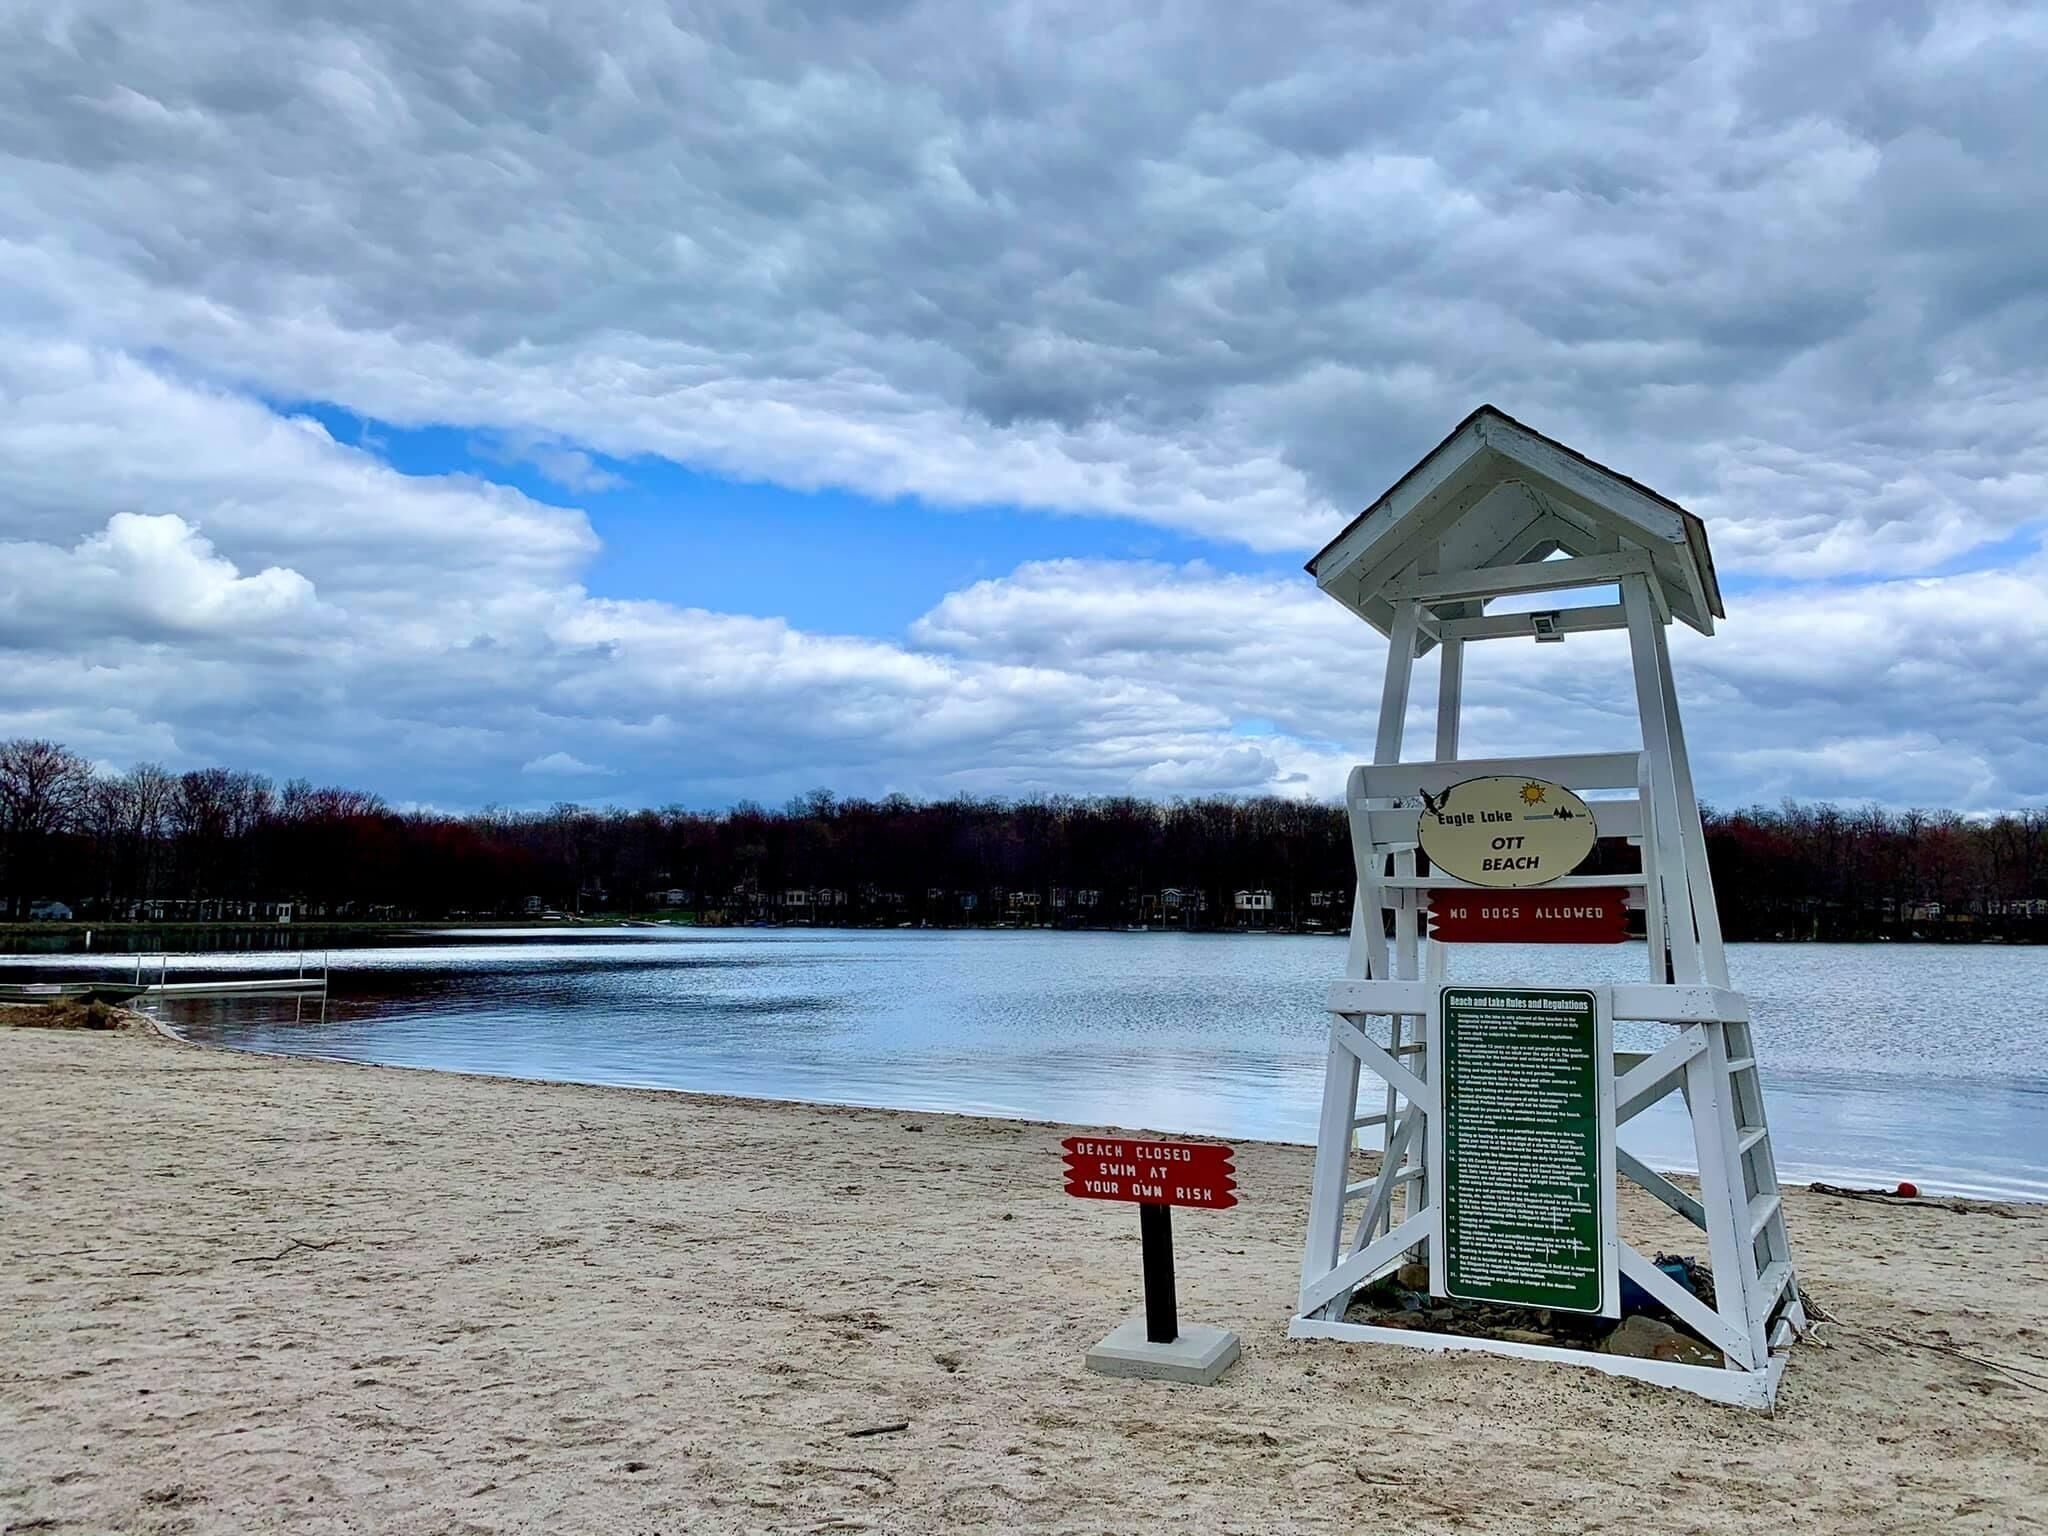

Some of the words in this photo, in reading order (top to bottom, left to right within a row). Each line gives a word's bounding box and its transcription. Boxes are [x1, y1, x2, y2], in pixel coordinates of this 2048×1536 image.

[1438, 812, 1475, 827] Eagle
[1481, 810, 1513, 824] Lake
[1491, 836, 1525, 850] OTT
[1482, 856, 1540, 871] BEACH
[1450, 908, 1468, 919] NO
[1482, 907, 1520, 919] DOGS
[1535, 907, 1604, 919] ALLOWED
[1450, 995, 1473, 1007] Beach
[1473, 996, 1487, 1007] and
[1488, 996, 1505, 1008] Lake
[1506, 997, 1527, 1009] Rules
[1527, 998, 1542, 1009] and
[1542, 998, 1589, 1011] Regulations
[1076, 1142, 1123, 1157] BEACH
[1136, 1146, 1192, 1162] CLOSED
[1099, 1163, 1136, 1177] SWIM
[1150, 1166, 1168, 1179] AT
[1084, 1180, 1119, 1194] YOUR
[1132, 1184, 1162, 1198] OWN
[1176, 1187, 1212, 1201] RISK
